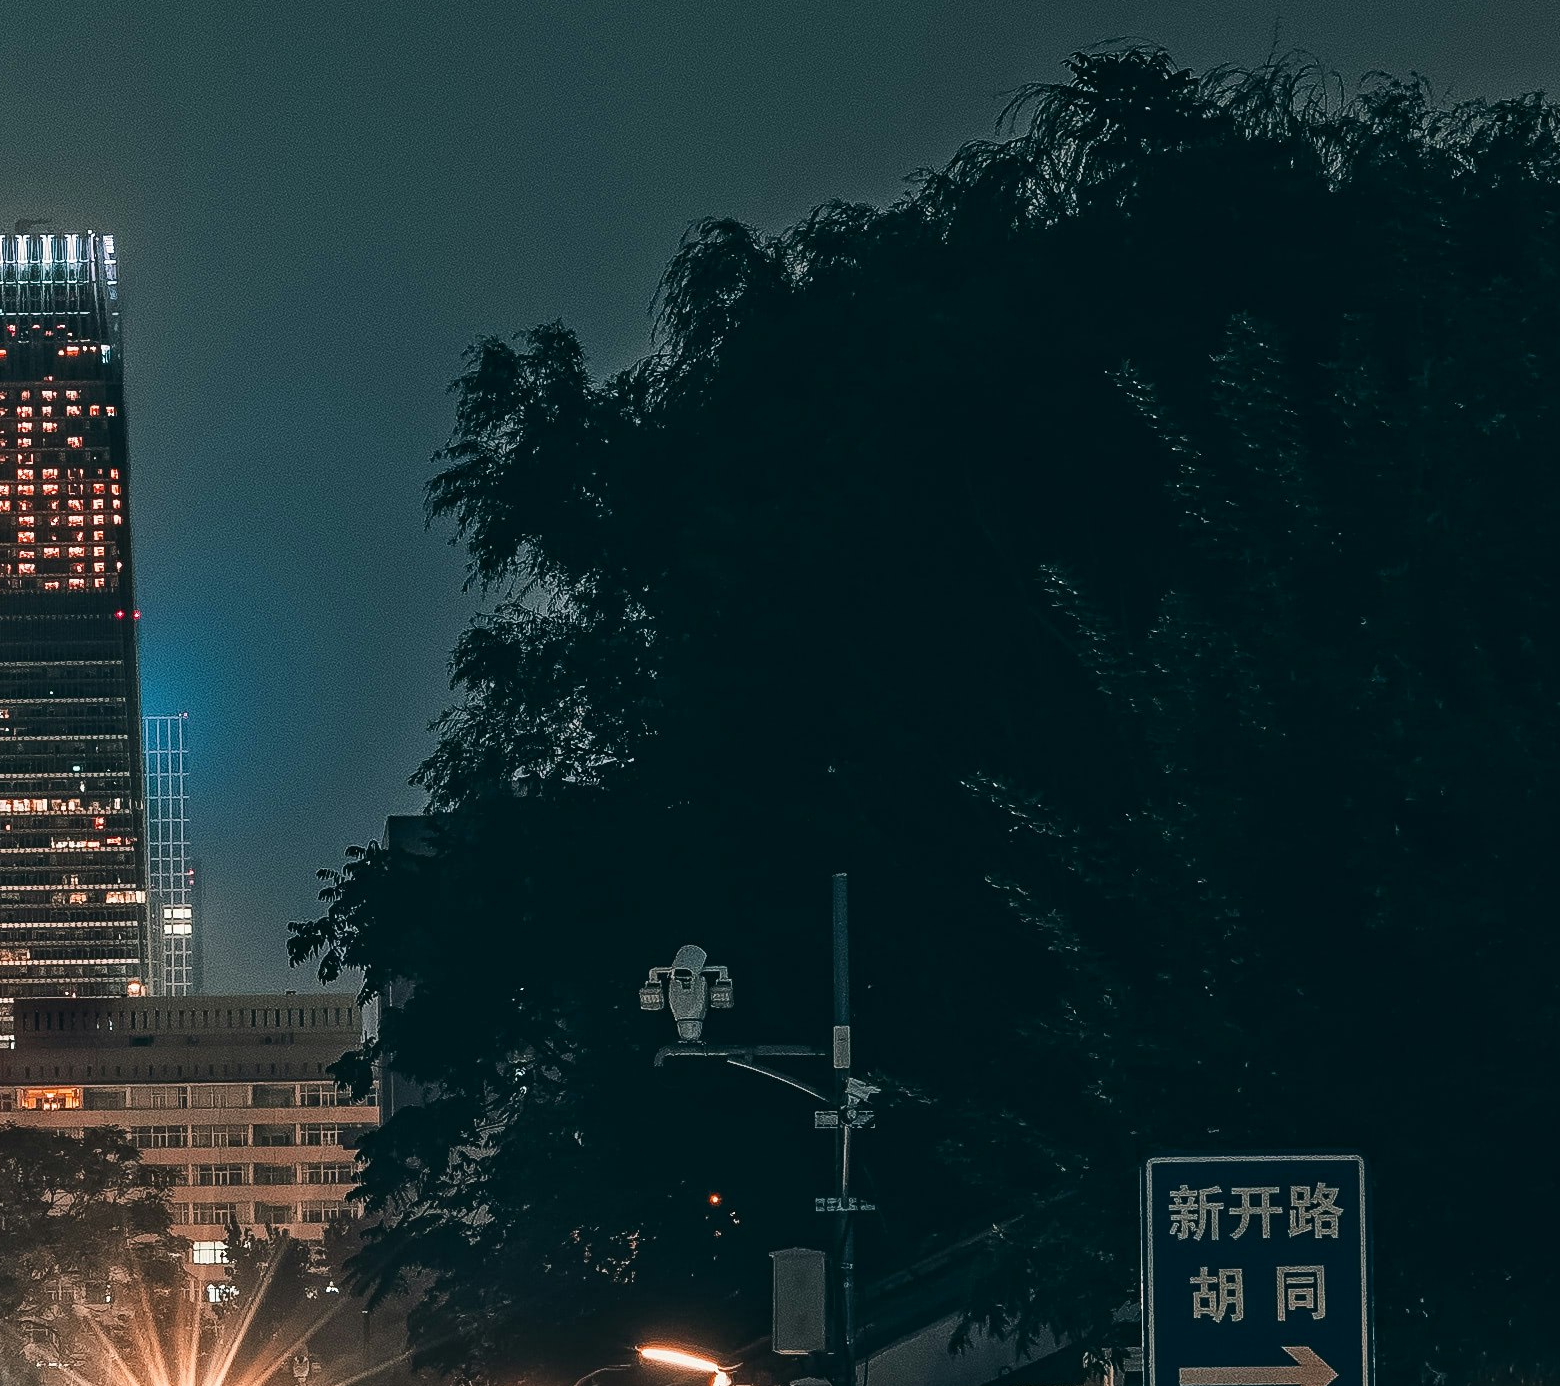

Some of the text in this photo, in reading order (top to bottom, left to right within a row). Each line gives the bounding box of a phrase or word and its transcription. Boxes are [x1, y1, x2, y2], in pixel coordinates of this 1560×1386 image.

[1169, 1182, 1344, 1241] 新开路
[1190, 1265, 1326, 1323] 胡同
